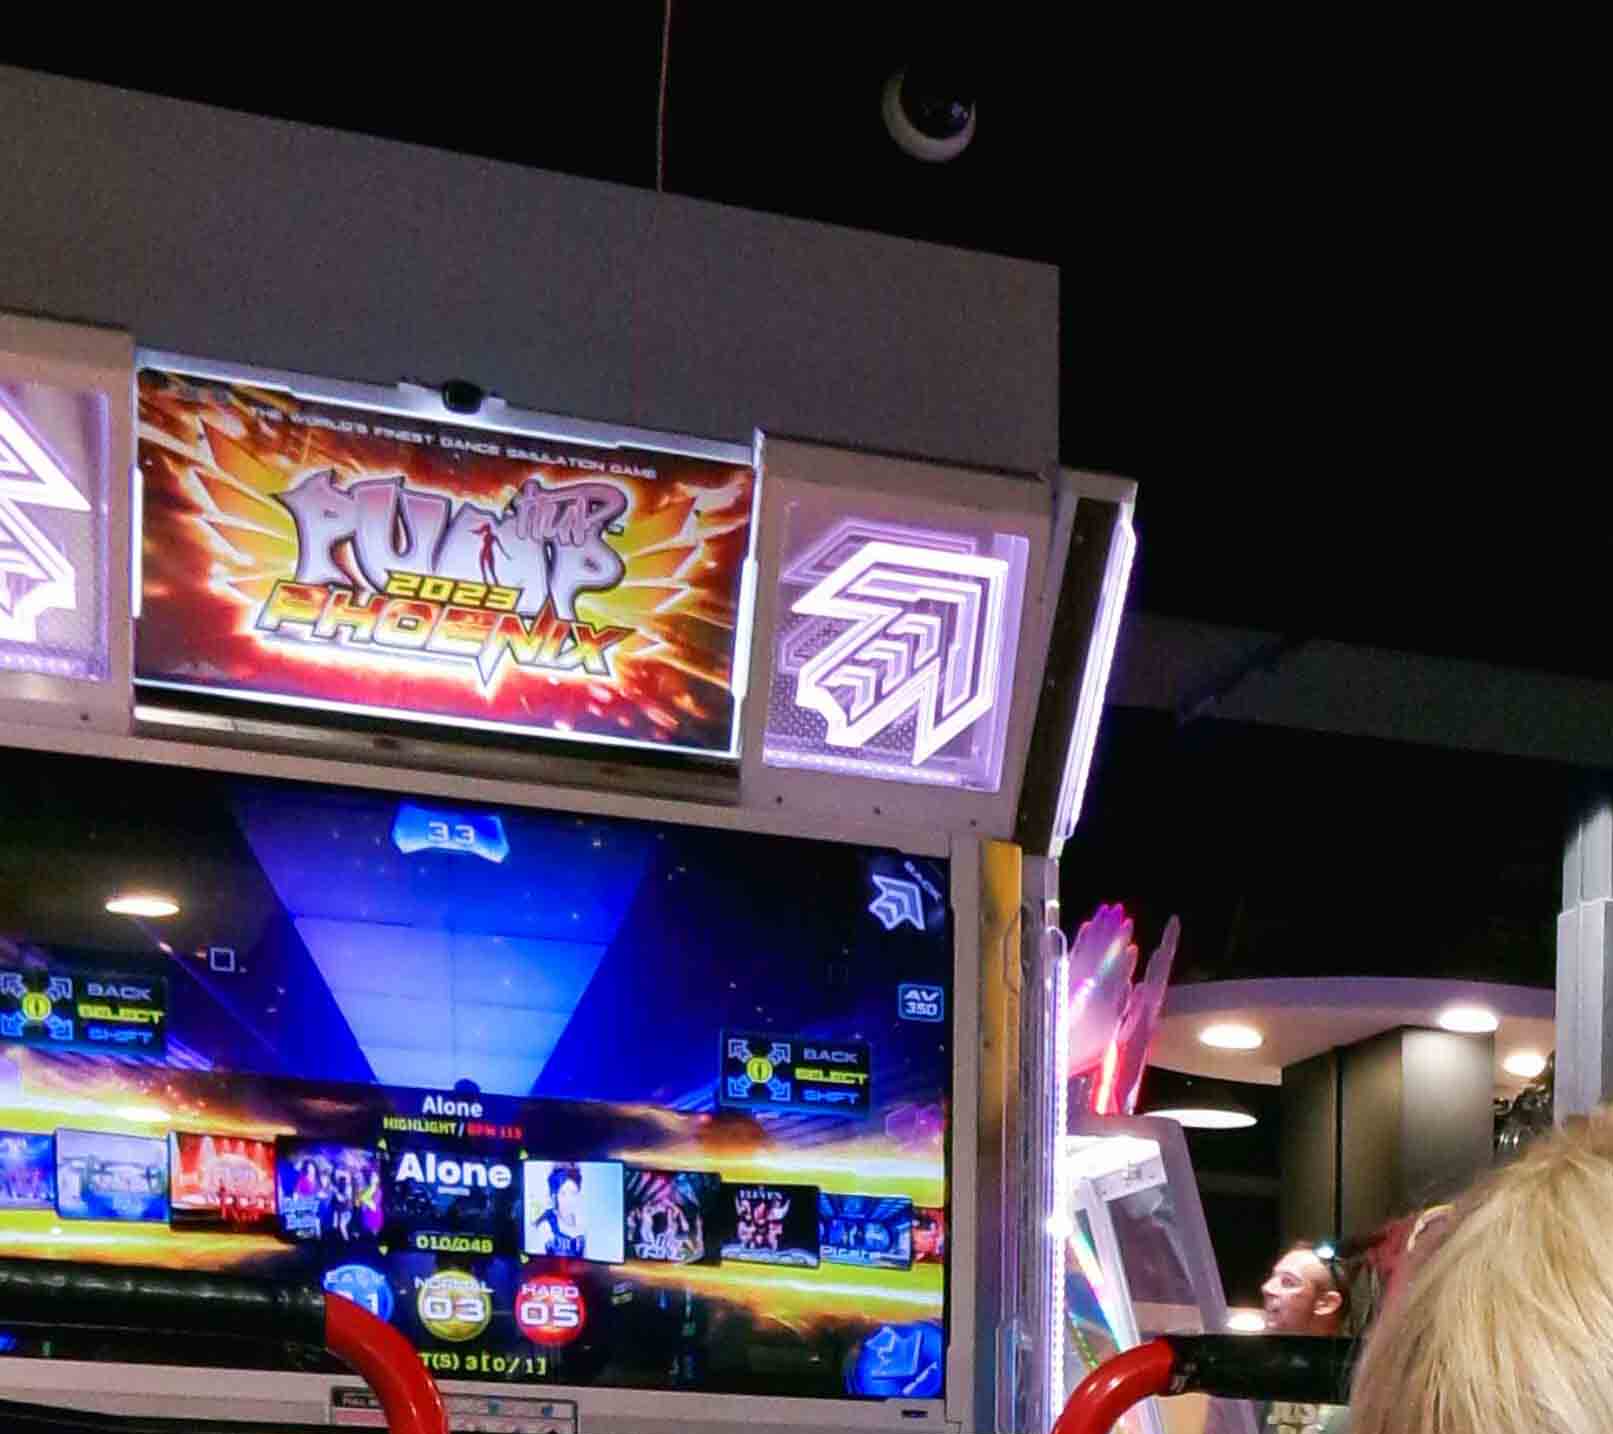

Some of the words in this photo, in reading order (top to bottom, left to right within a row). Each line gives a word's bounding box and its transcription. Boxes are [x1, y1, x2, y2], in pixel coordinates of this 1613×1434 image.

[386, 571, 522, 609] 2023
[254, 579, 637, 688] PHOENIX
[87, 983, 152, 1000] BACK
[904, 989, 940, 1001] AV
[803, 1048, 859, 1064] BACK
[421, 1095, 484, 1119] Alone
[383, 1116, 457, 1136] HIGHLIGHT
[395, 1153, 512, 1190] Alone
[522, 1283, 579, 1299] HARD
[422, 1295, 486, 1320] 03
[520, 1303, 580, 1327] 05
